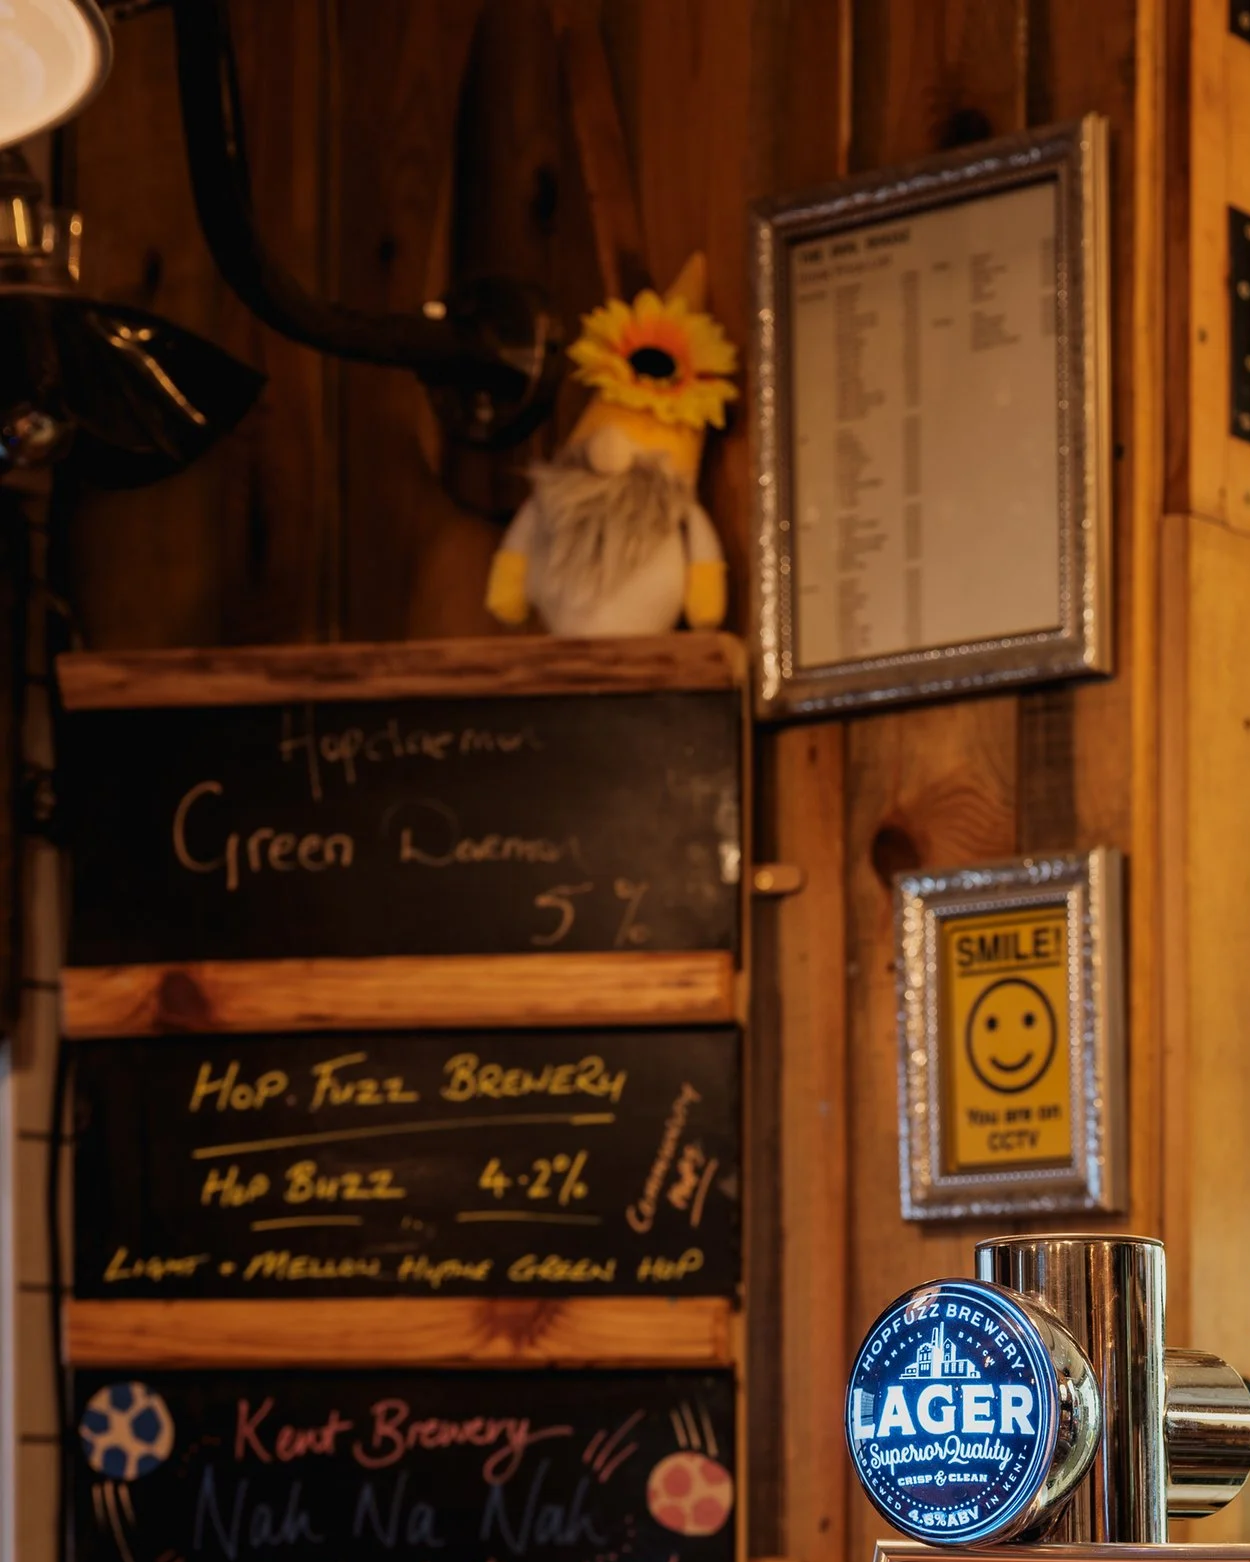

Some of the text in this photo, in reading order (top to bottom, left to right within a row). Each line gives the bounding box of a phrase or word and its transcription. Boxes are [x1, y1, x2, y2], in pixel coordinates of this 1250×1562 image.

[173, 781, 353, 890] Green
[957, 927, 1062, 967] SMILE!
[988, 1128, 1040, 1152] CCTV
[884, 1331, 996, 1367] SMALL BATCH
[946, 1303, 1024, 1370] BREWERY
[853, 1384, 1036, 1439] LAGER
[233, 1398, 573, 1483] Kent Brewery
[870, 1435, 1014, 1476] Superior Quality
[859, 1453, 1027, 1511] BREWED IN KENT
[898, 1470, 988, 1487] CRISP & CLEAN
